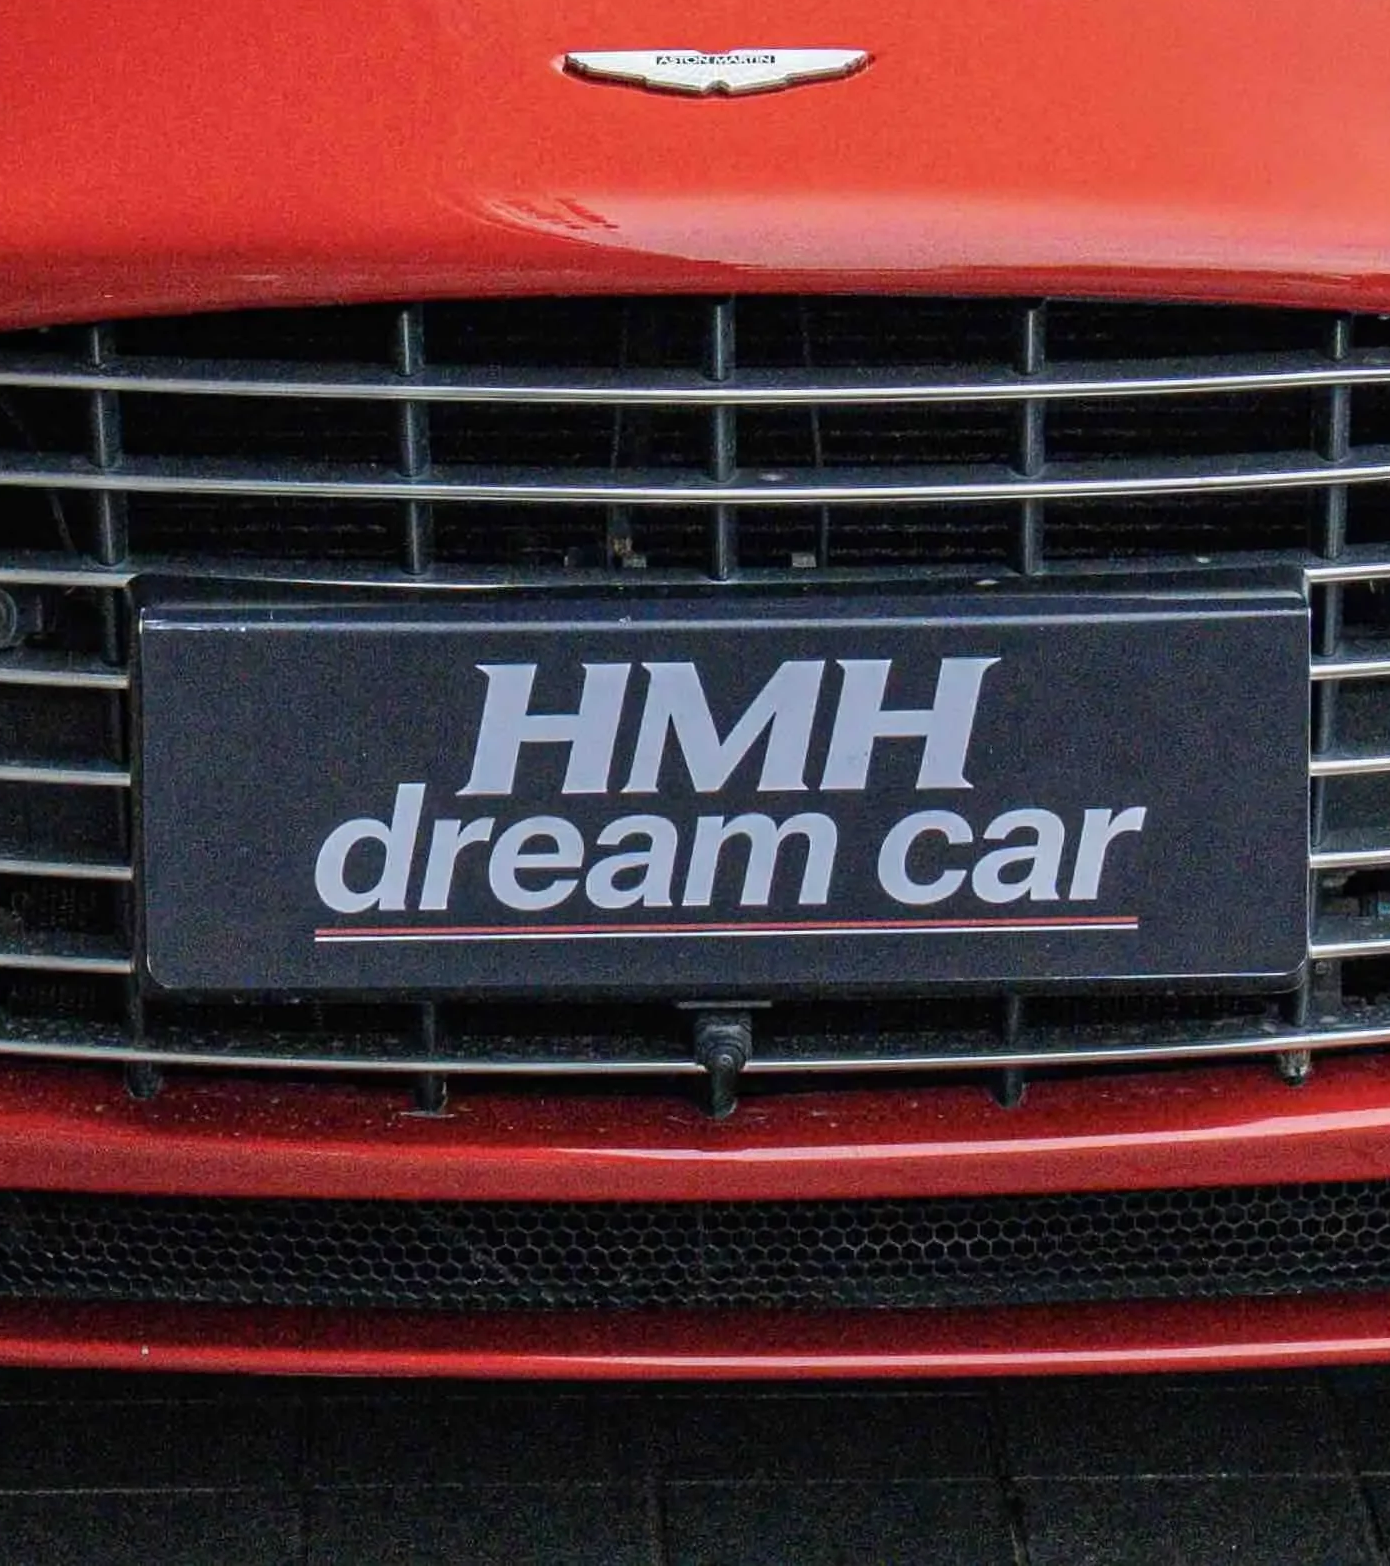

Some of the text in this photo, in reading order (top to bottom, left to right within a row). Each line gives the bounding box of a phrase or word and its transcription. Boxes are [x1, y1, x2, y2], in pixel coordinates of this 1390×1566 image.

[456, 657, 1002, 796] HMH
[313, 783, 1148, 914] dream car
